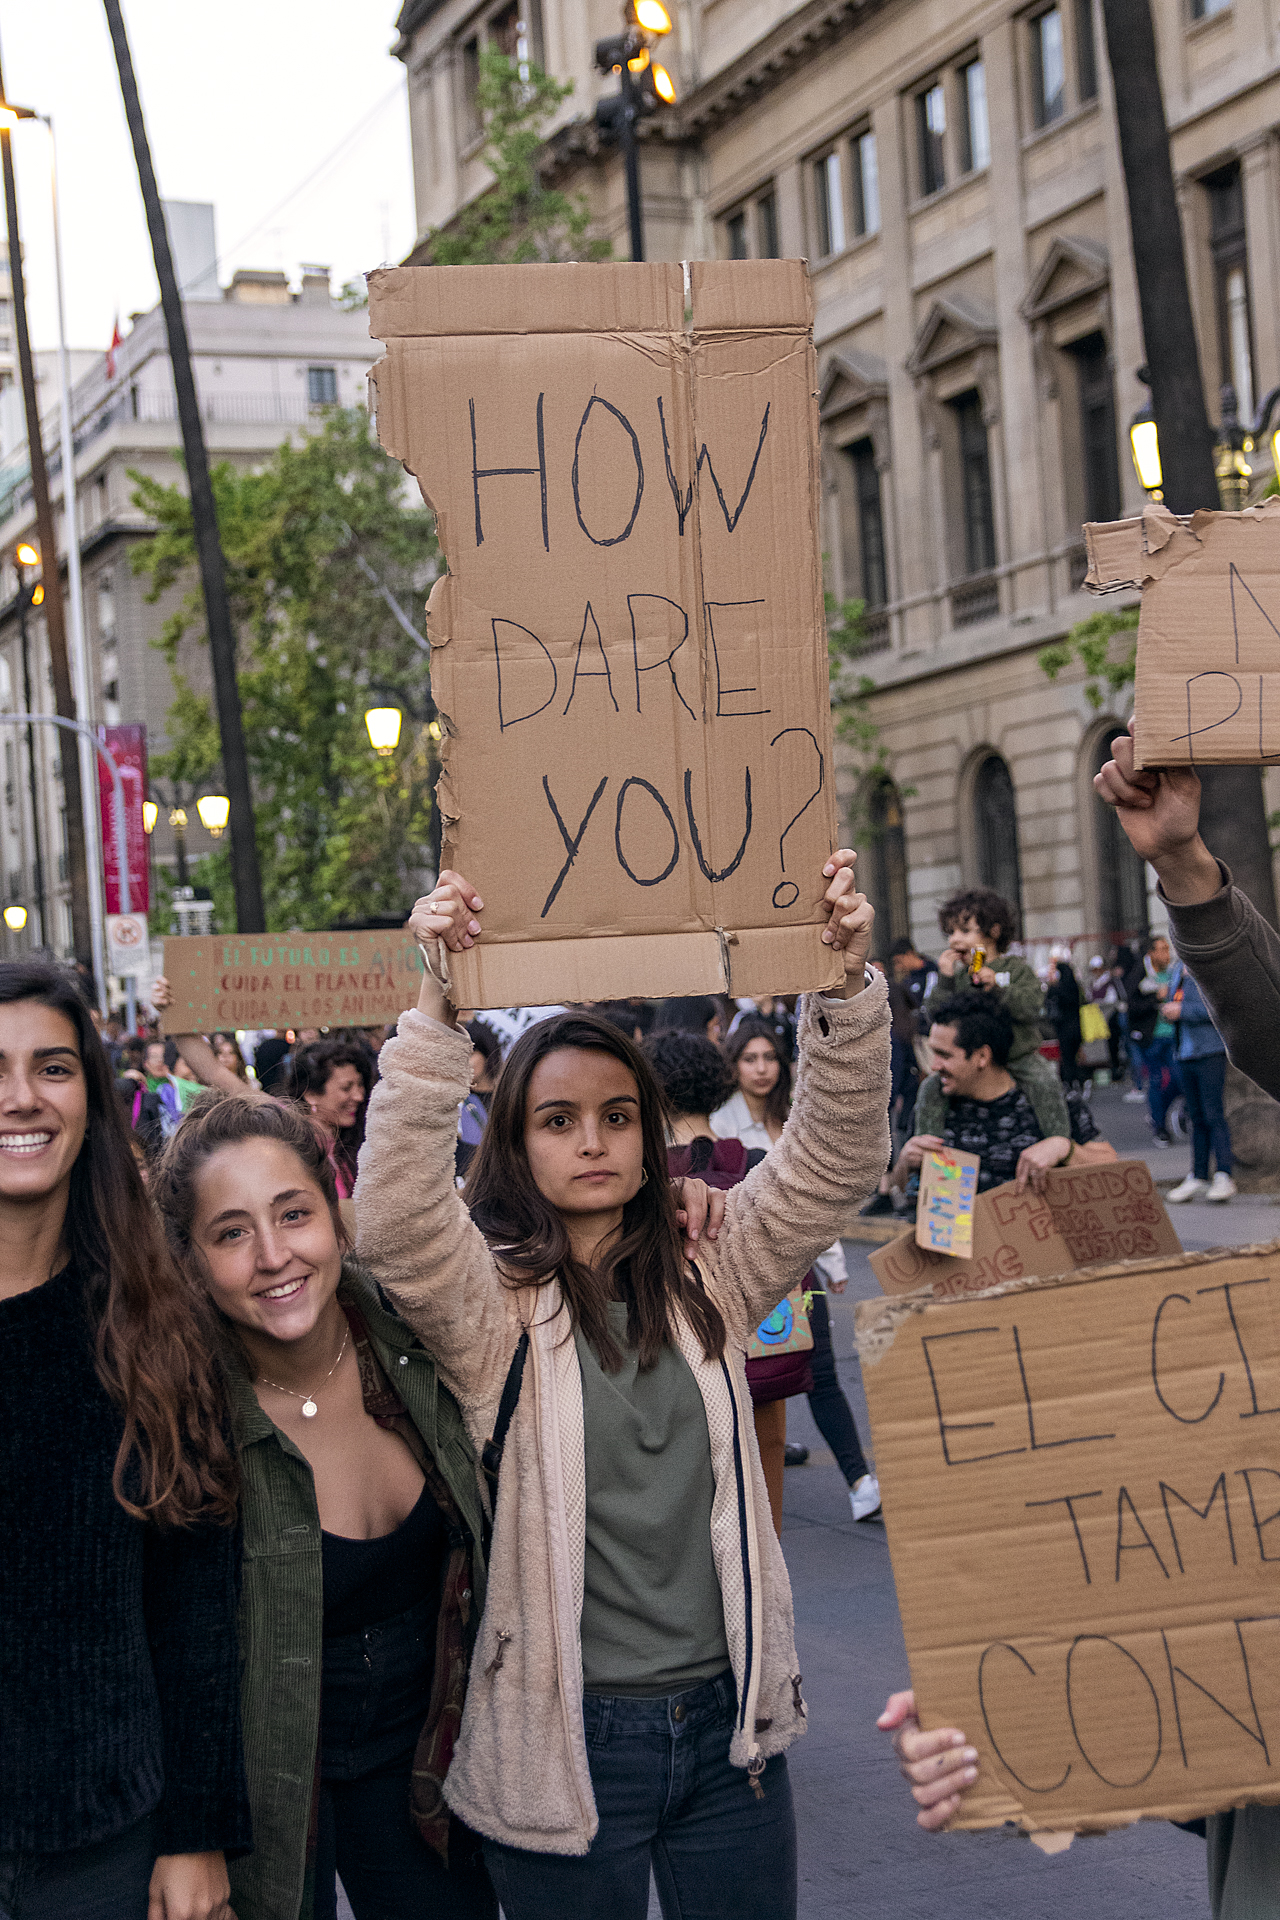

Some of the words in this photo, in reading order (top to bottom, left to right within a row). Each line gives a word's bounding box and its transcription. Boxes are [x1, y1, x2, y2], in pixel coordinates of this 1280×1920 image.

[468, 384, 771, 552] HOW
[491, 593, 772, 733] DARE
[541, 727, 825, 918] YOU?
[216, 999, 271, 1021] CUIDA
[280, 1000, 292, 1018] A
[302, 997, 333, 1017] LOS
[220, 974, 274, 993] CUIDA
[283, 974, 306, 993] EL
[315, 970, 396, 992] PLANETA
[223, 947, 244, 967] EL
[250, 946, 330, 967] FUTURO
[339, 946, 360, 967] ES
[920, 1325, 1116, 1466] EL
